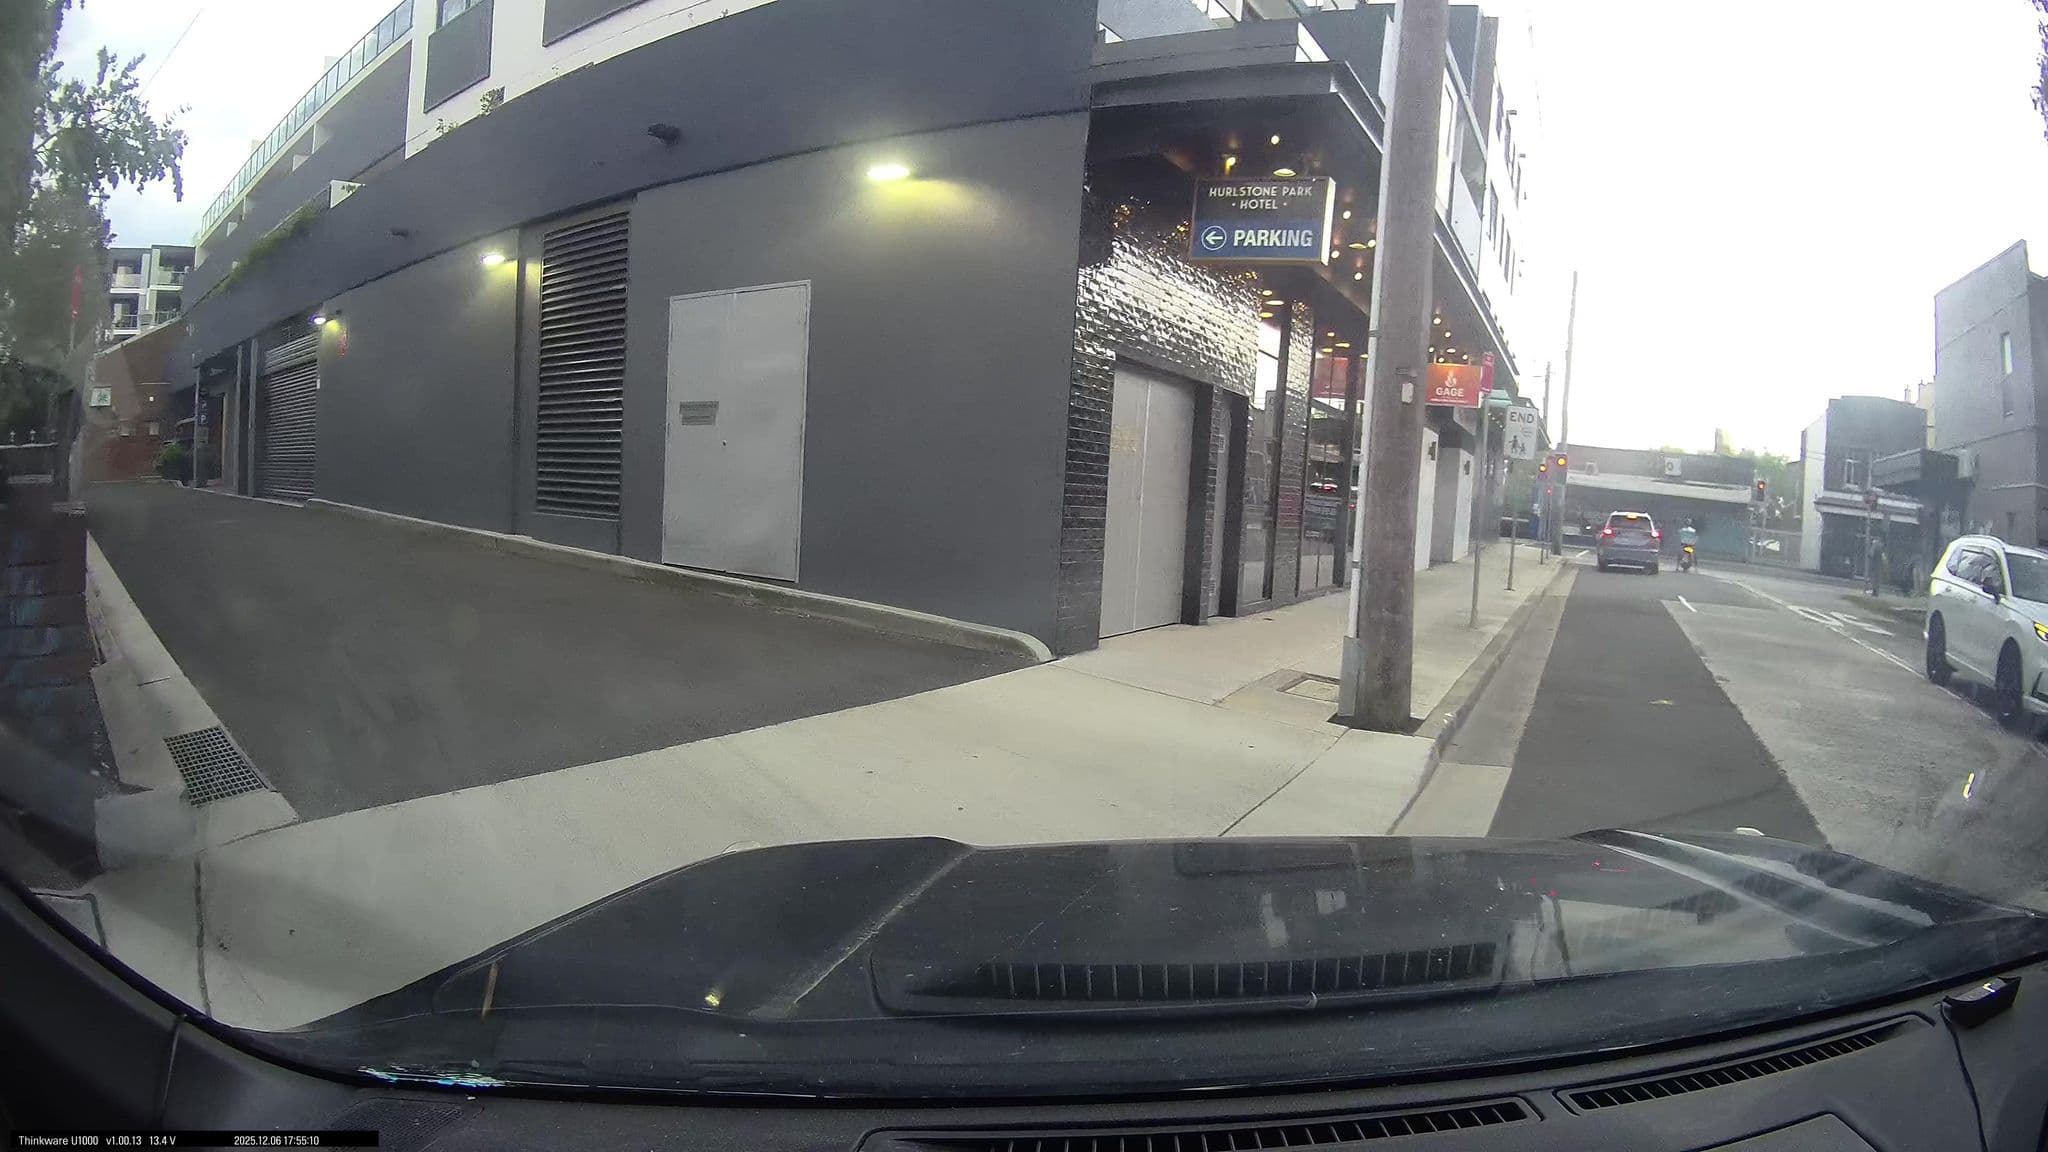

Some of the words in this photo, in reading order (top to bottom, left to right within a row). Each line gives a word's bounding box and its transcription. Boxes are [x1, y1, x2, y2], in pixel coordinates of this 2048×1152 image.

[1209, 186, 1277, 198] HURLSTONE
[1282, 186, 1313, 197] PARK
[1240, 199, 1278, 210] HOTEL
[1233, 229, 1313, 247] PARKING
[1435, 387, 1465, 397] GAGE
[1510, 411, 1535, 424] END
